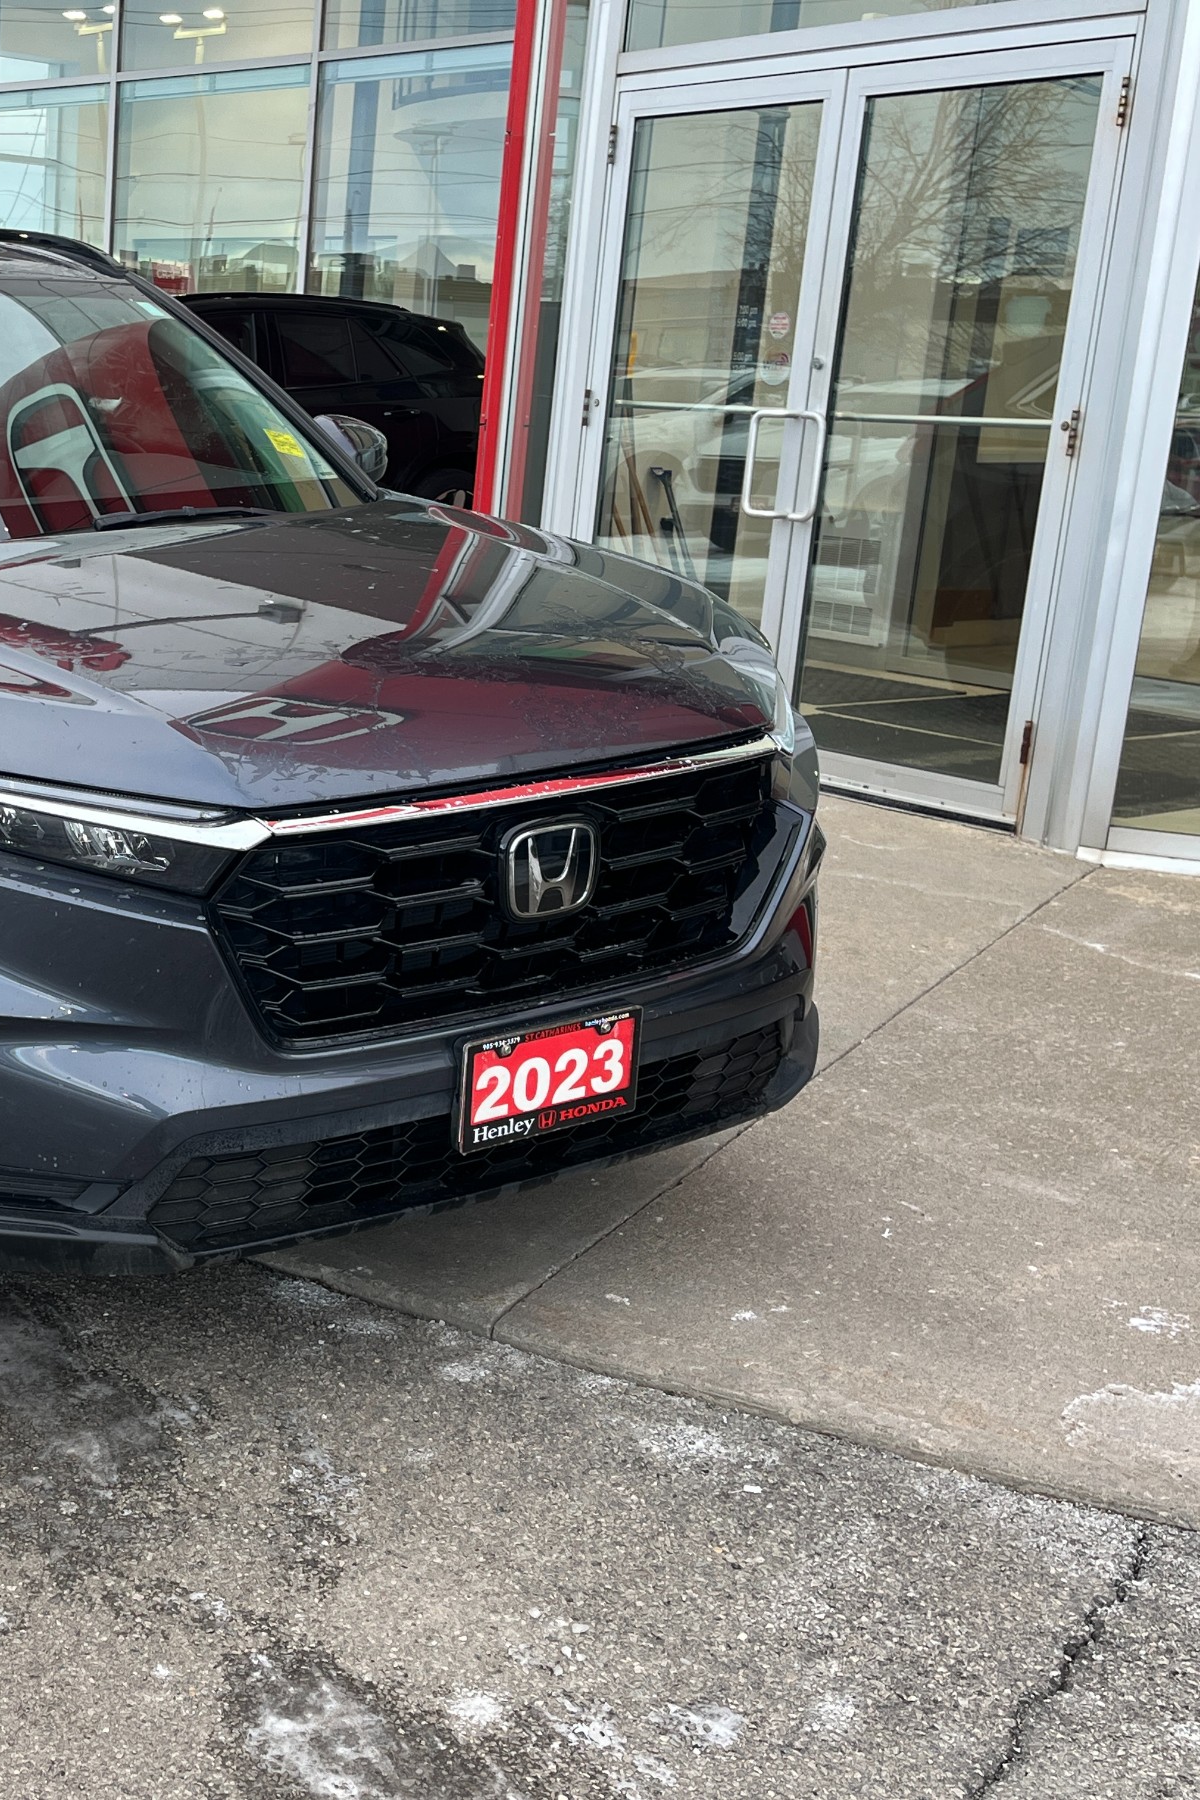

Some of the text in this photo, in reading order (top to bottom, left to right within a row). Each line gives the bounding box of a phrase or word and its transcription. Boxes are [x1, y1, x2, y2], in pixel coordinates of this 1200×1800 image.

[473, 1038, 624, 1124] 2023
[472, 1117, 536, 1144] Henley
[558, 1096, 628, 1122] HONDA
